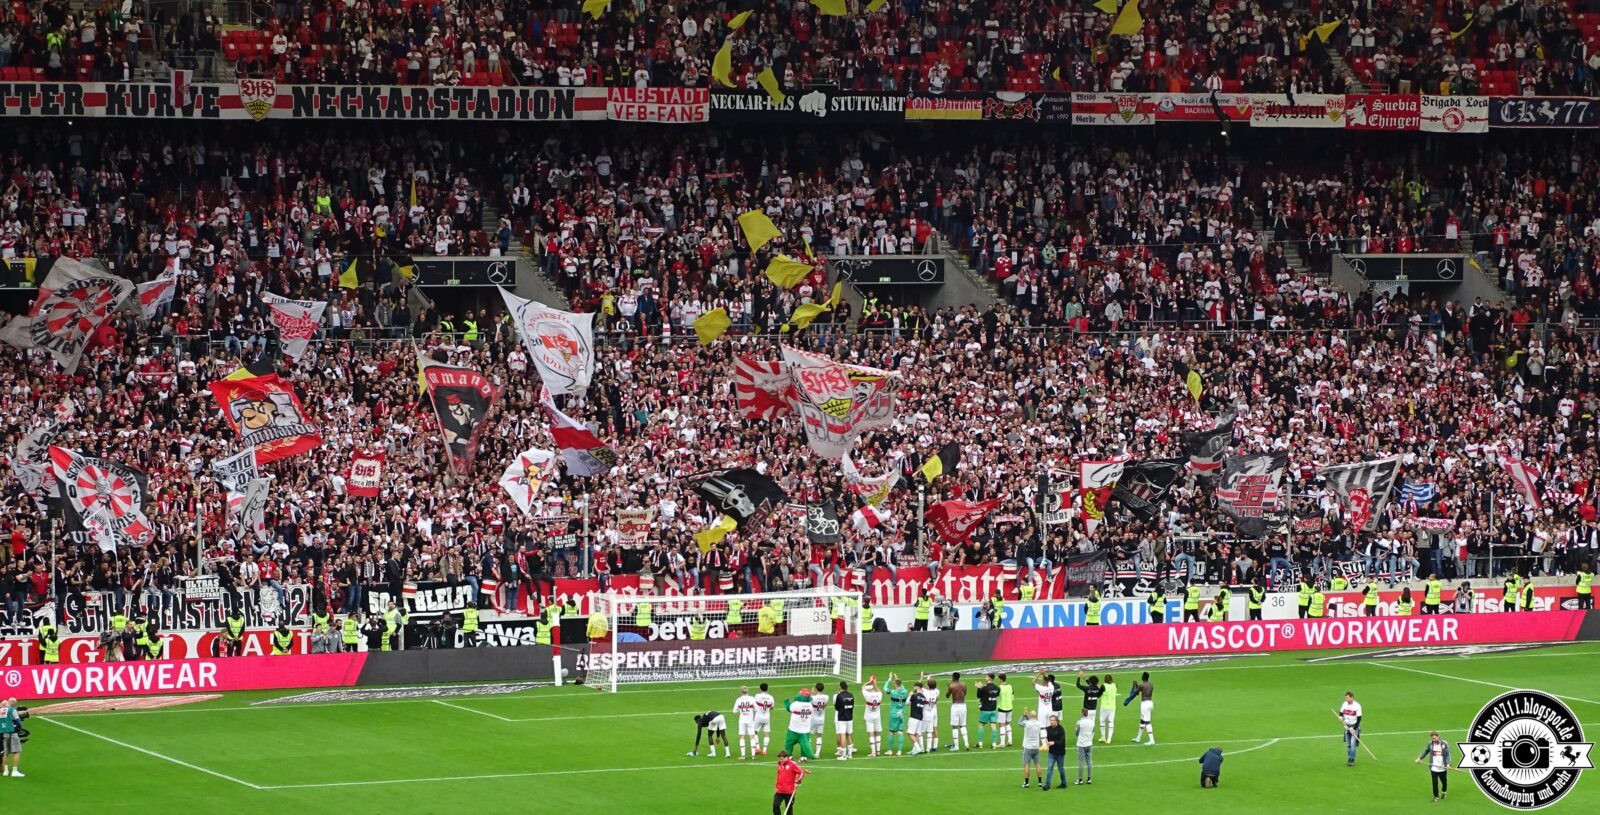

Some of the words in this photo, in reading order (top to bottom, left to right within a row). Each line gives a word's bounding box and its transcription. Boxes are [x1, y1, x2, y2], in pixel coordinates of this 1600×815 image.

[292, 86, 575, 119] NECKARSTADION
[612, 88, 707, 103] ALBSTADT
[1422, 96, 1461, 108] Brigada
[831, 95, 905, 113] STUTTGART
[935, 97, 982, 111] Warriors
[1372, 99, 1417, 111] Suebia
[613, 104, 704, 122] VFB-FANS
[1232, 485, 1267, 507] 36
[185, 578, 220, 589] ULTRAS
[1271, 596, 1286, 608] 36
[812, 610, 827, 623] 35
[1302, 618, 1459, 646] WORKWEAR
[576, 650, 665, 672] RESPEKT
[668, 645, 706, 668] FÜR
[711, 647, 767, 665] DEINE
[772, 643, 837, 663] ARBEIT
[31, 661, 218, 695] WORKWEAR
[675, 671, 694, 680] Bank
[758, 667, 777, 676] Bank
[741, 701, 750, 713] 22
